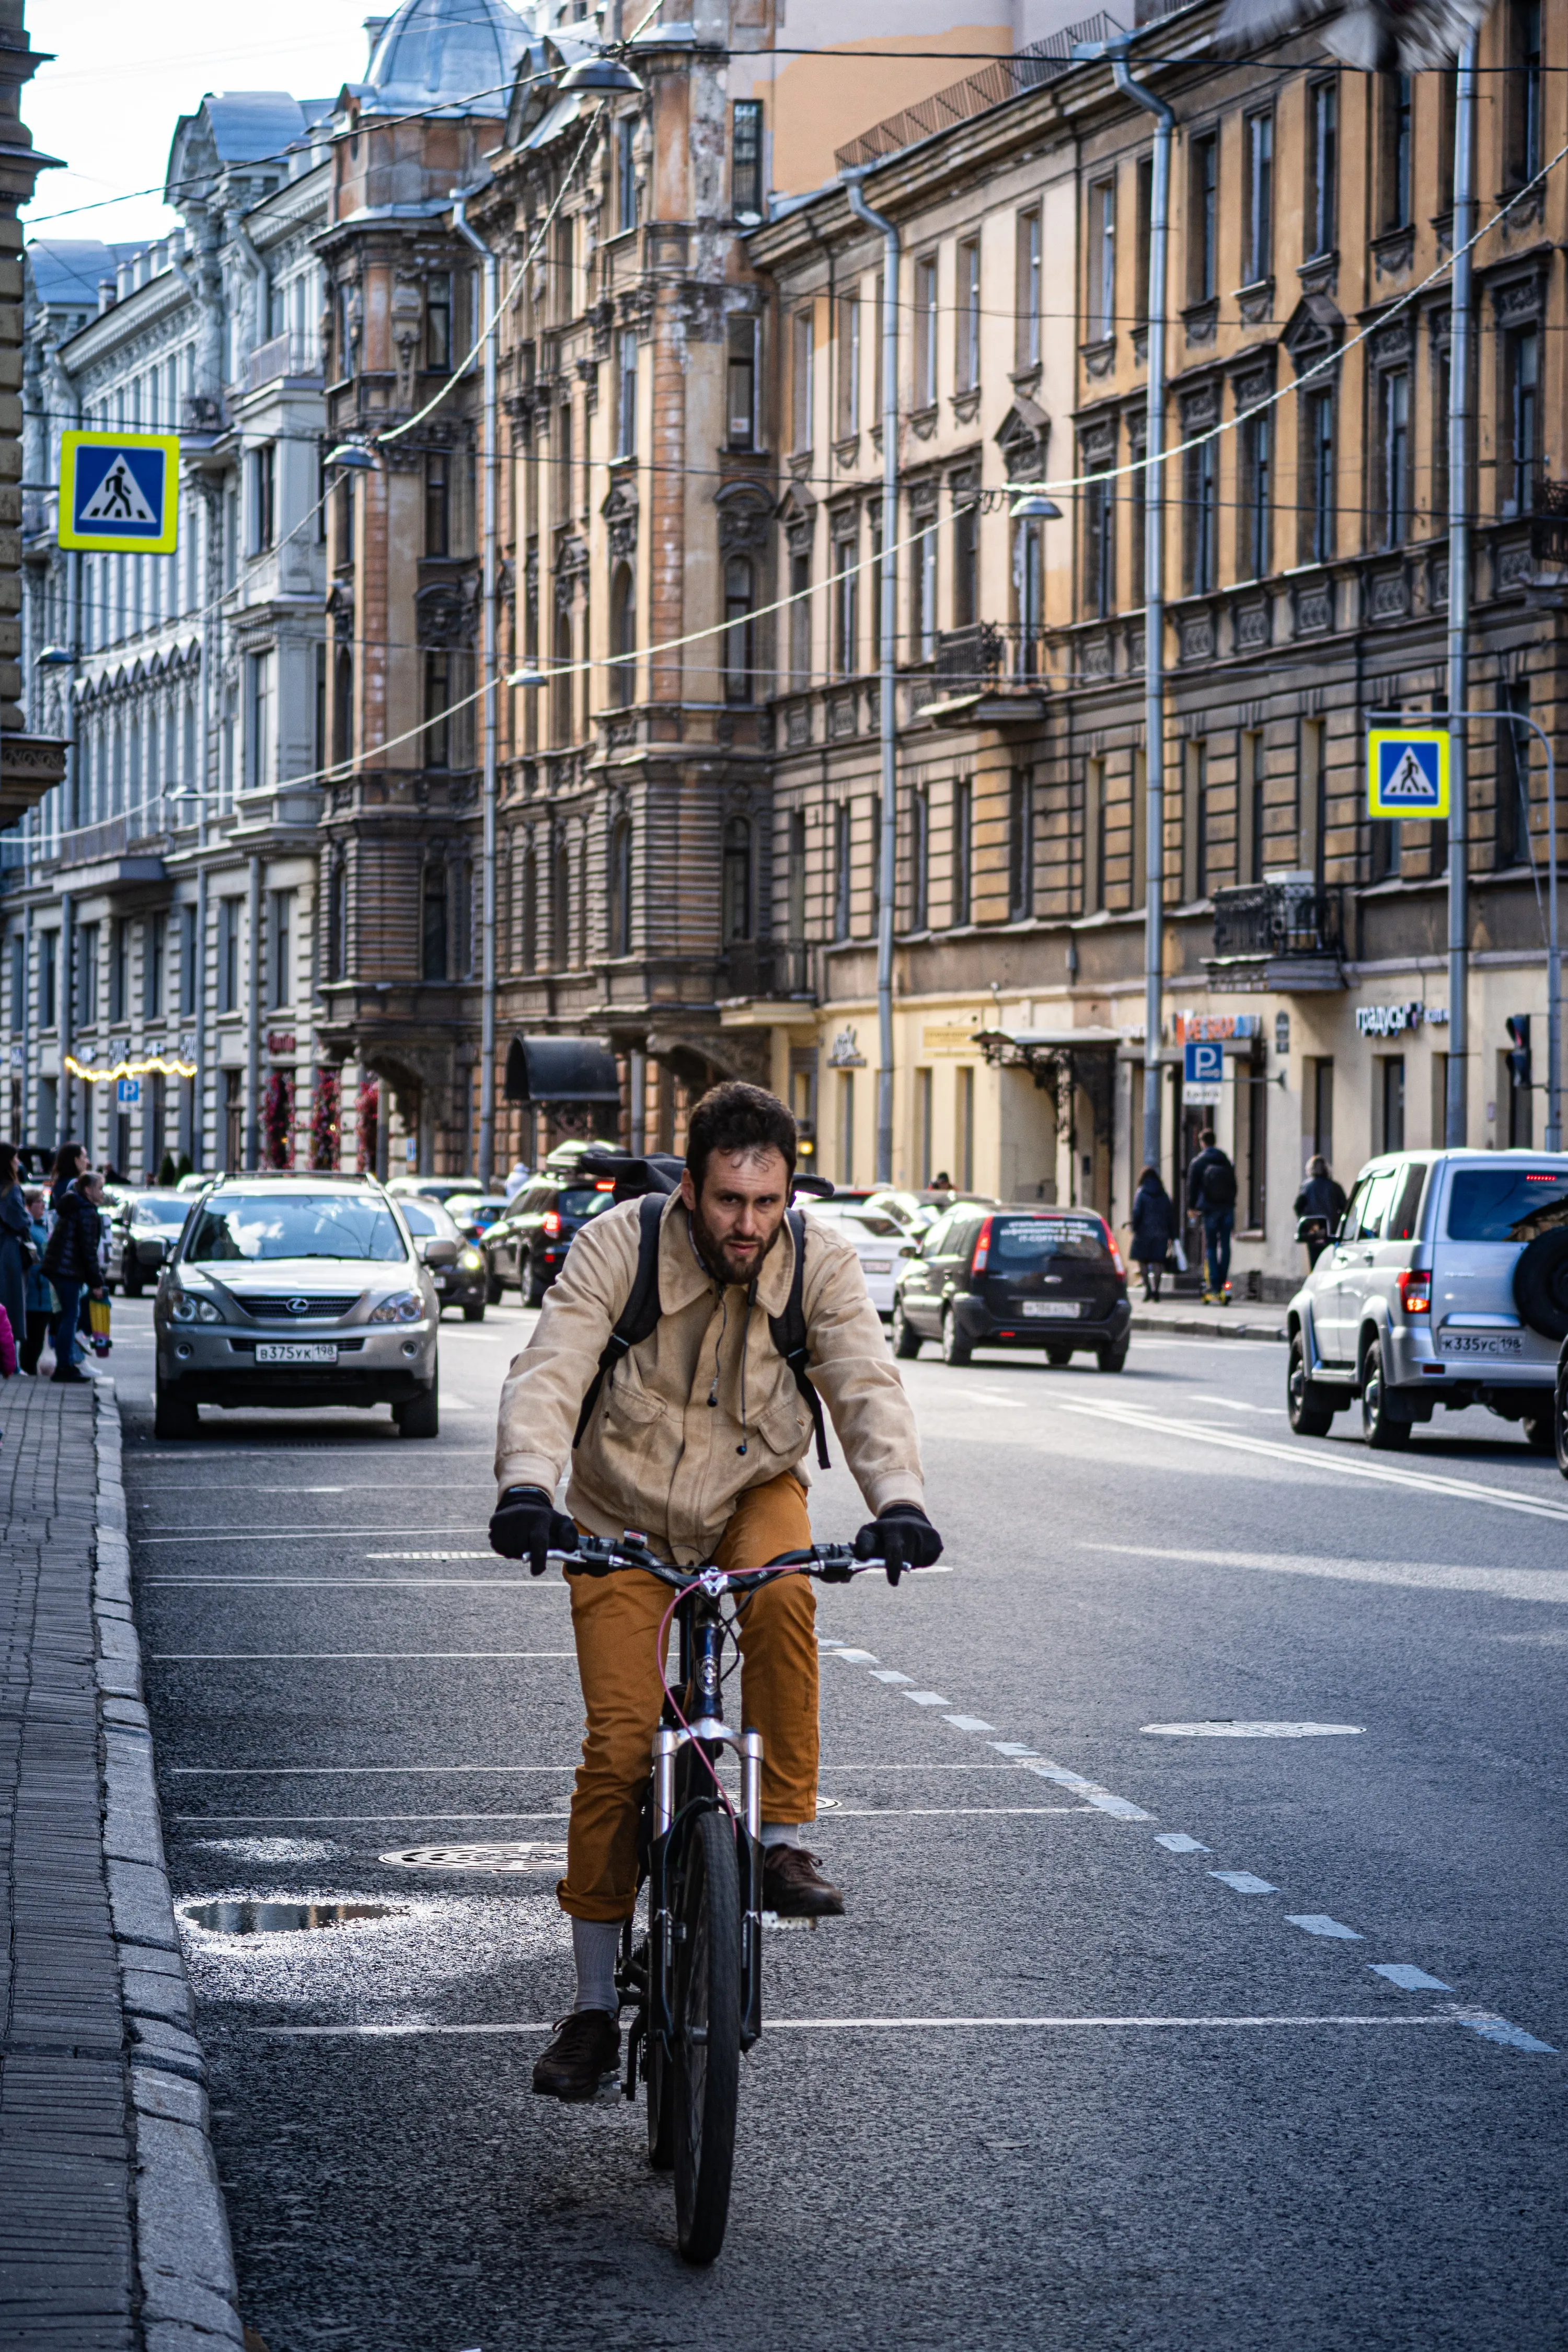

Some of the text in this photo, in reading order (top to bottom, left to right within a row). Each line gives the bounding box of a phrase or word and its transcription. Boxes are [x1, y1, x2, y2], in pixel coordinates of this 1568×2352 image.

[1195, 1047, 1217, 1079] P
[260, 1346, 333, 1359] В375УК 198
